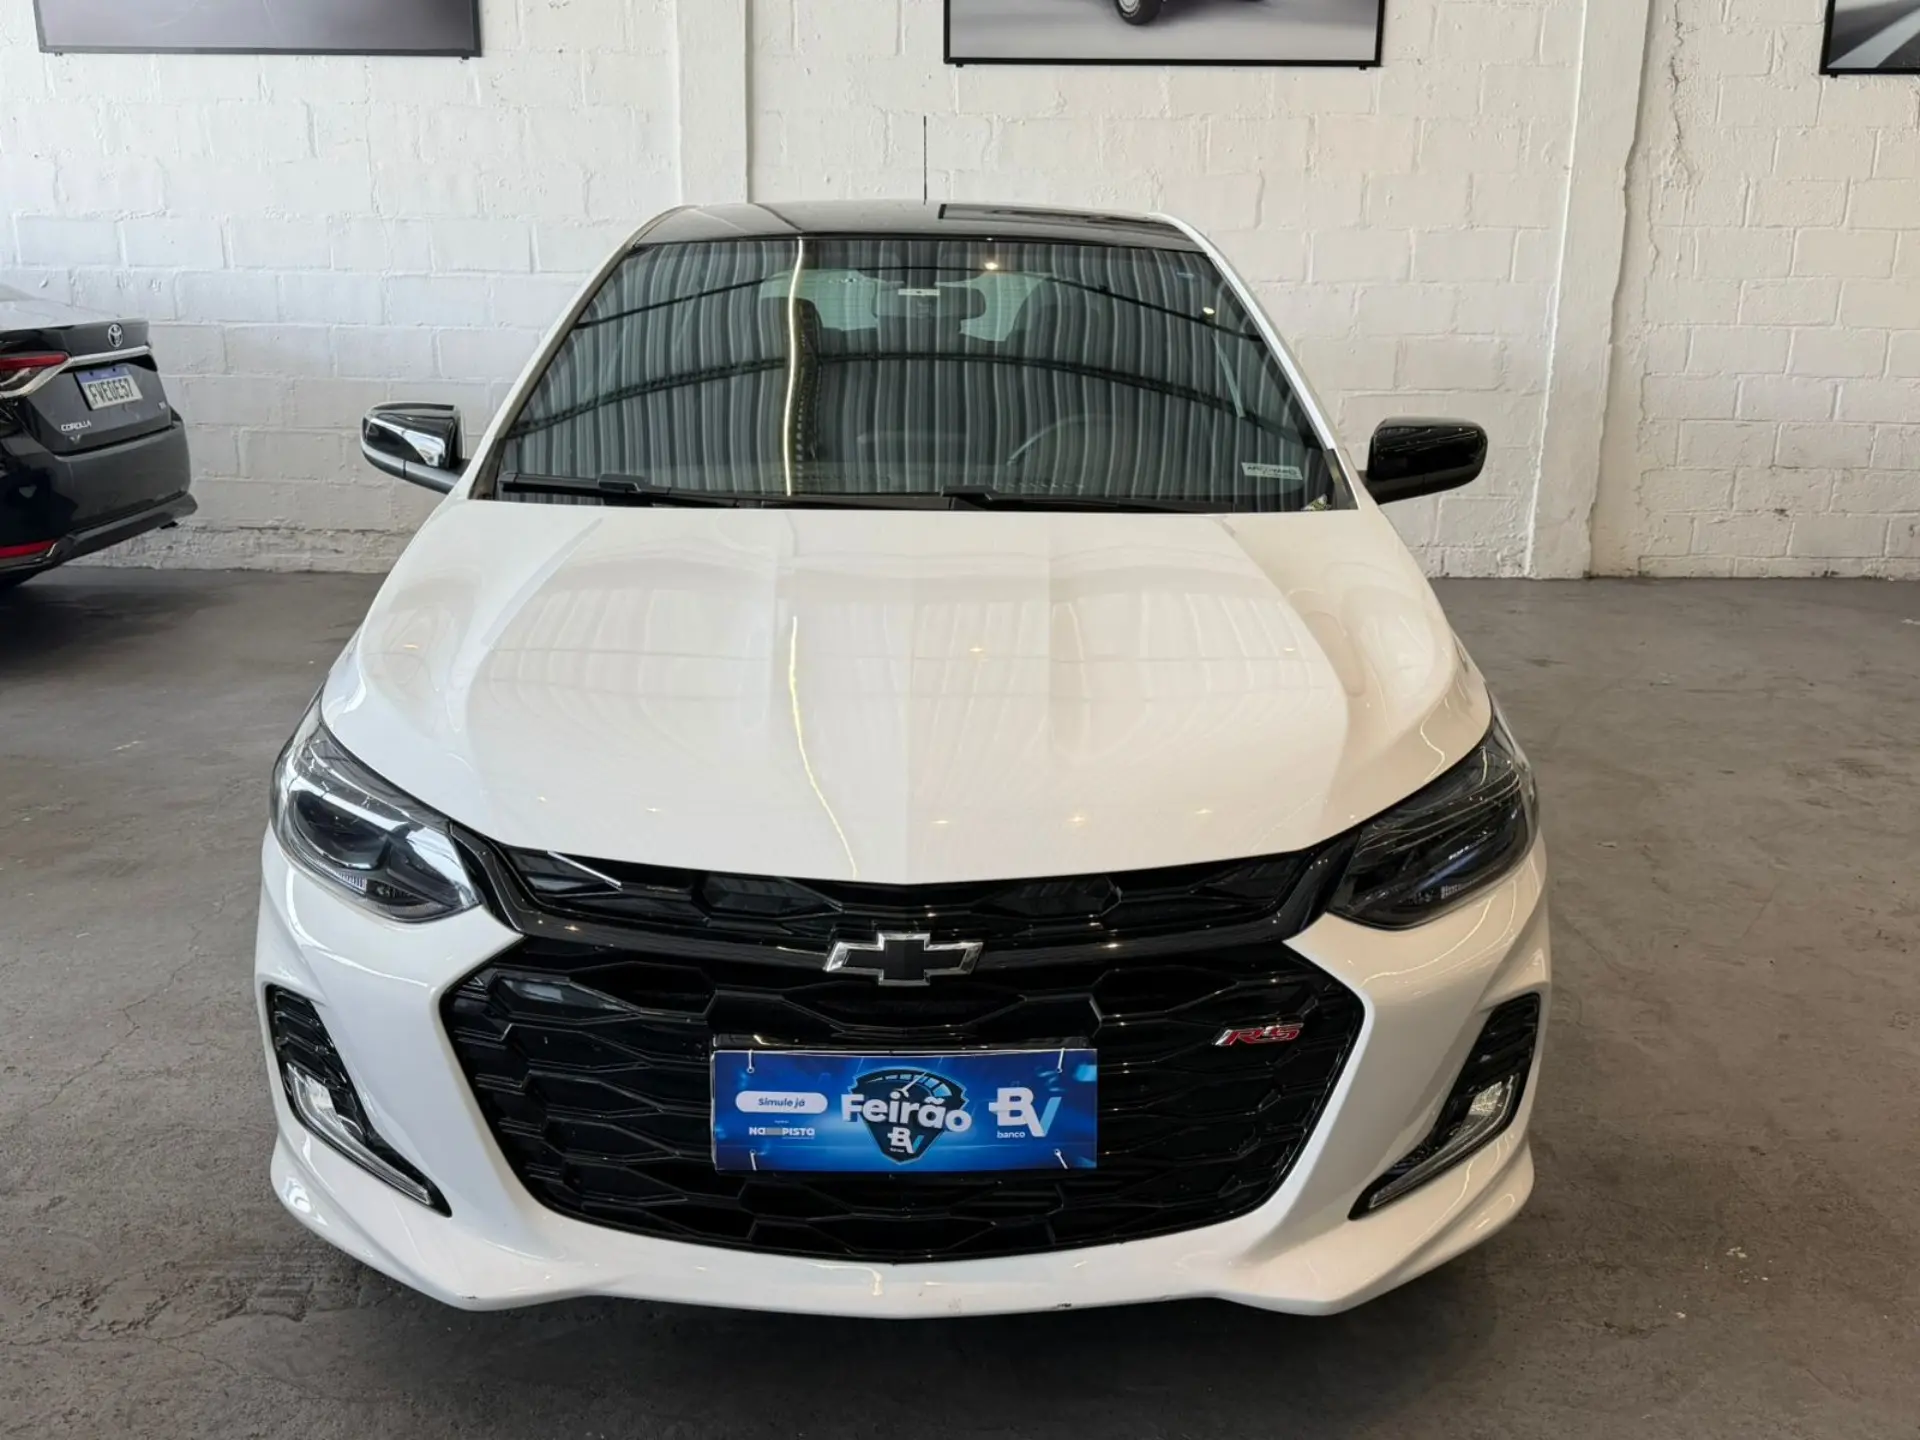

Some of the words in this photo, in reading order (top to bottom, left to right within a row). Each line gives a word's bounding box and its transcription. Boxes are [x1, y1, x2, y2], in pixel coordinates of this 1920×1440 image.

[61, 421, 92, 431] COROLLA
[1214, 1023, 1304, 1046] RS
[758, 1097, 793, 1107] Simule
[841, 1091, 972, 1132] Feirão
[988, 1086, 1062, 1137] BV
[996, 1130, 1026, 1139] banco
